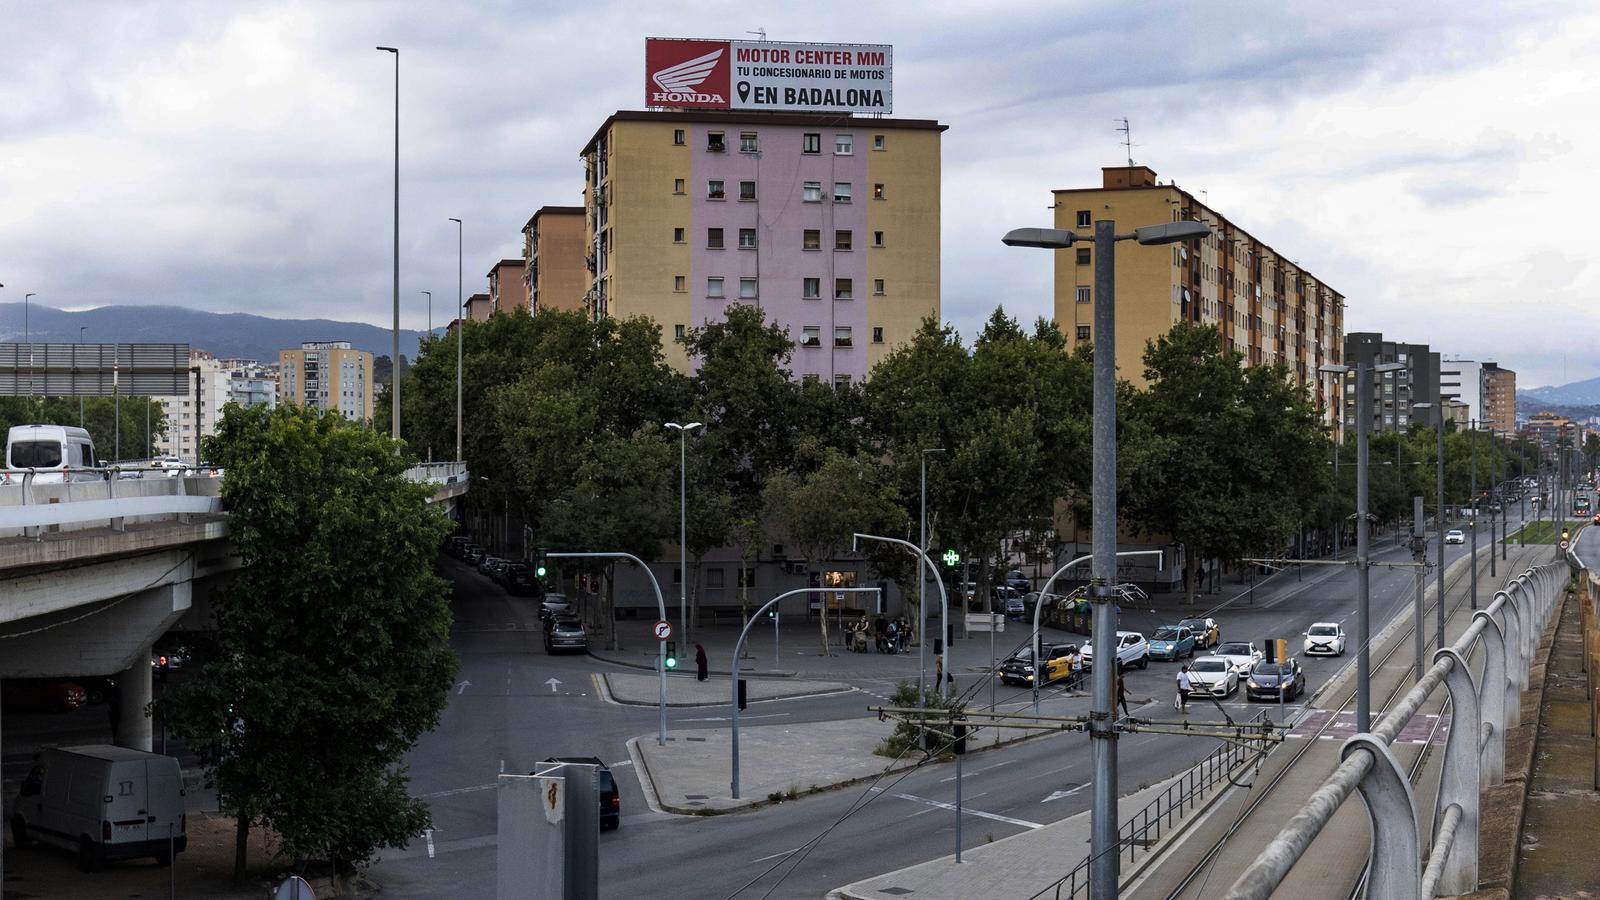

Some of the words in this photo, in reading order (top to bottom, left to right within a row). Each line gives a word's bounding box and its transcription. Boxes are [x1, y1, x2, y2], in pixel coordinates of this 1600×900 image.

[737, 48, 790, 63] MOTOR
[795, 50, 852, 65] CENTER
[857, 52, 885, 66] MM
[737, 66, 750, 76] TU
[752, 67, 831, 79] CONCESIONARIO
[834, 70, 847, 79] DE
[850, 70, 885, 80] MOTOS
[653, 92, 725, 103] HONDA
[754, 87, 777, 104] EN
[784, 87, 885, 107] BADALONA
